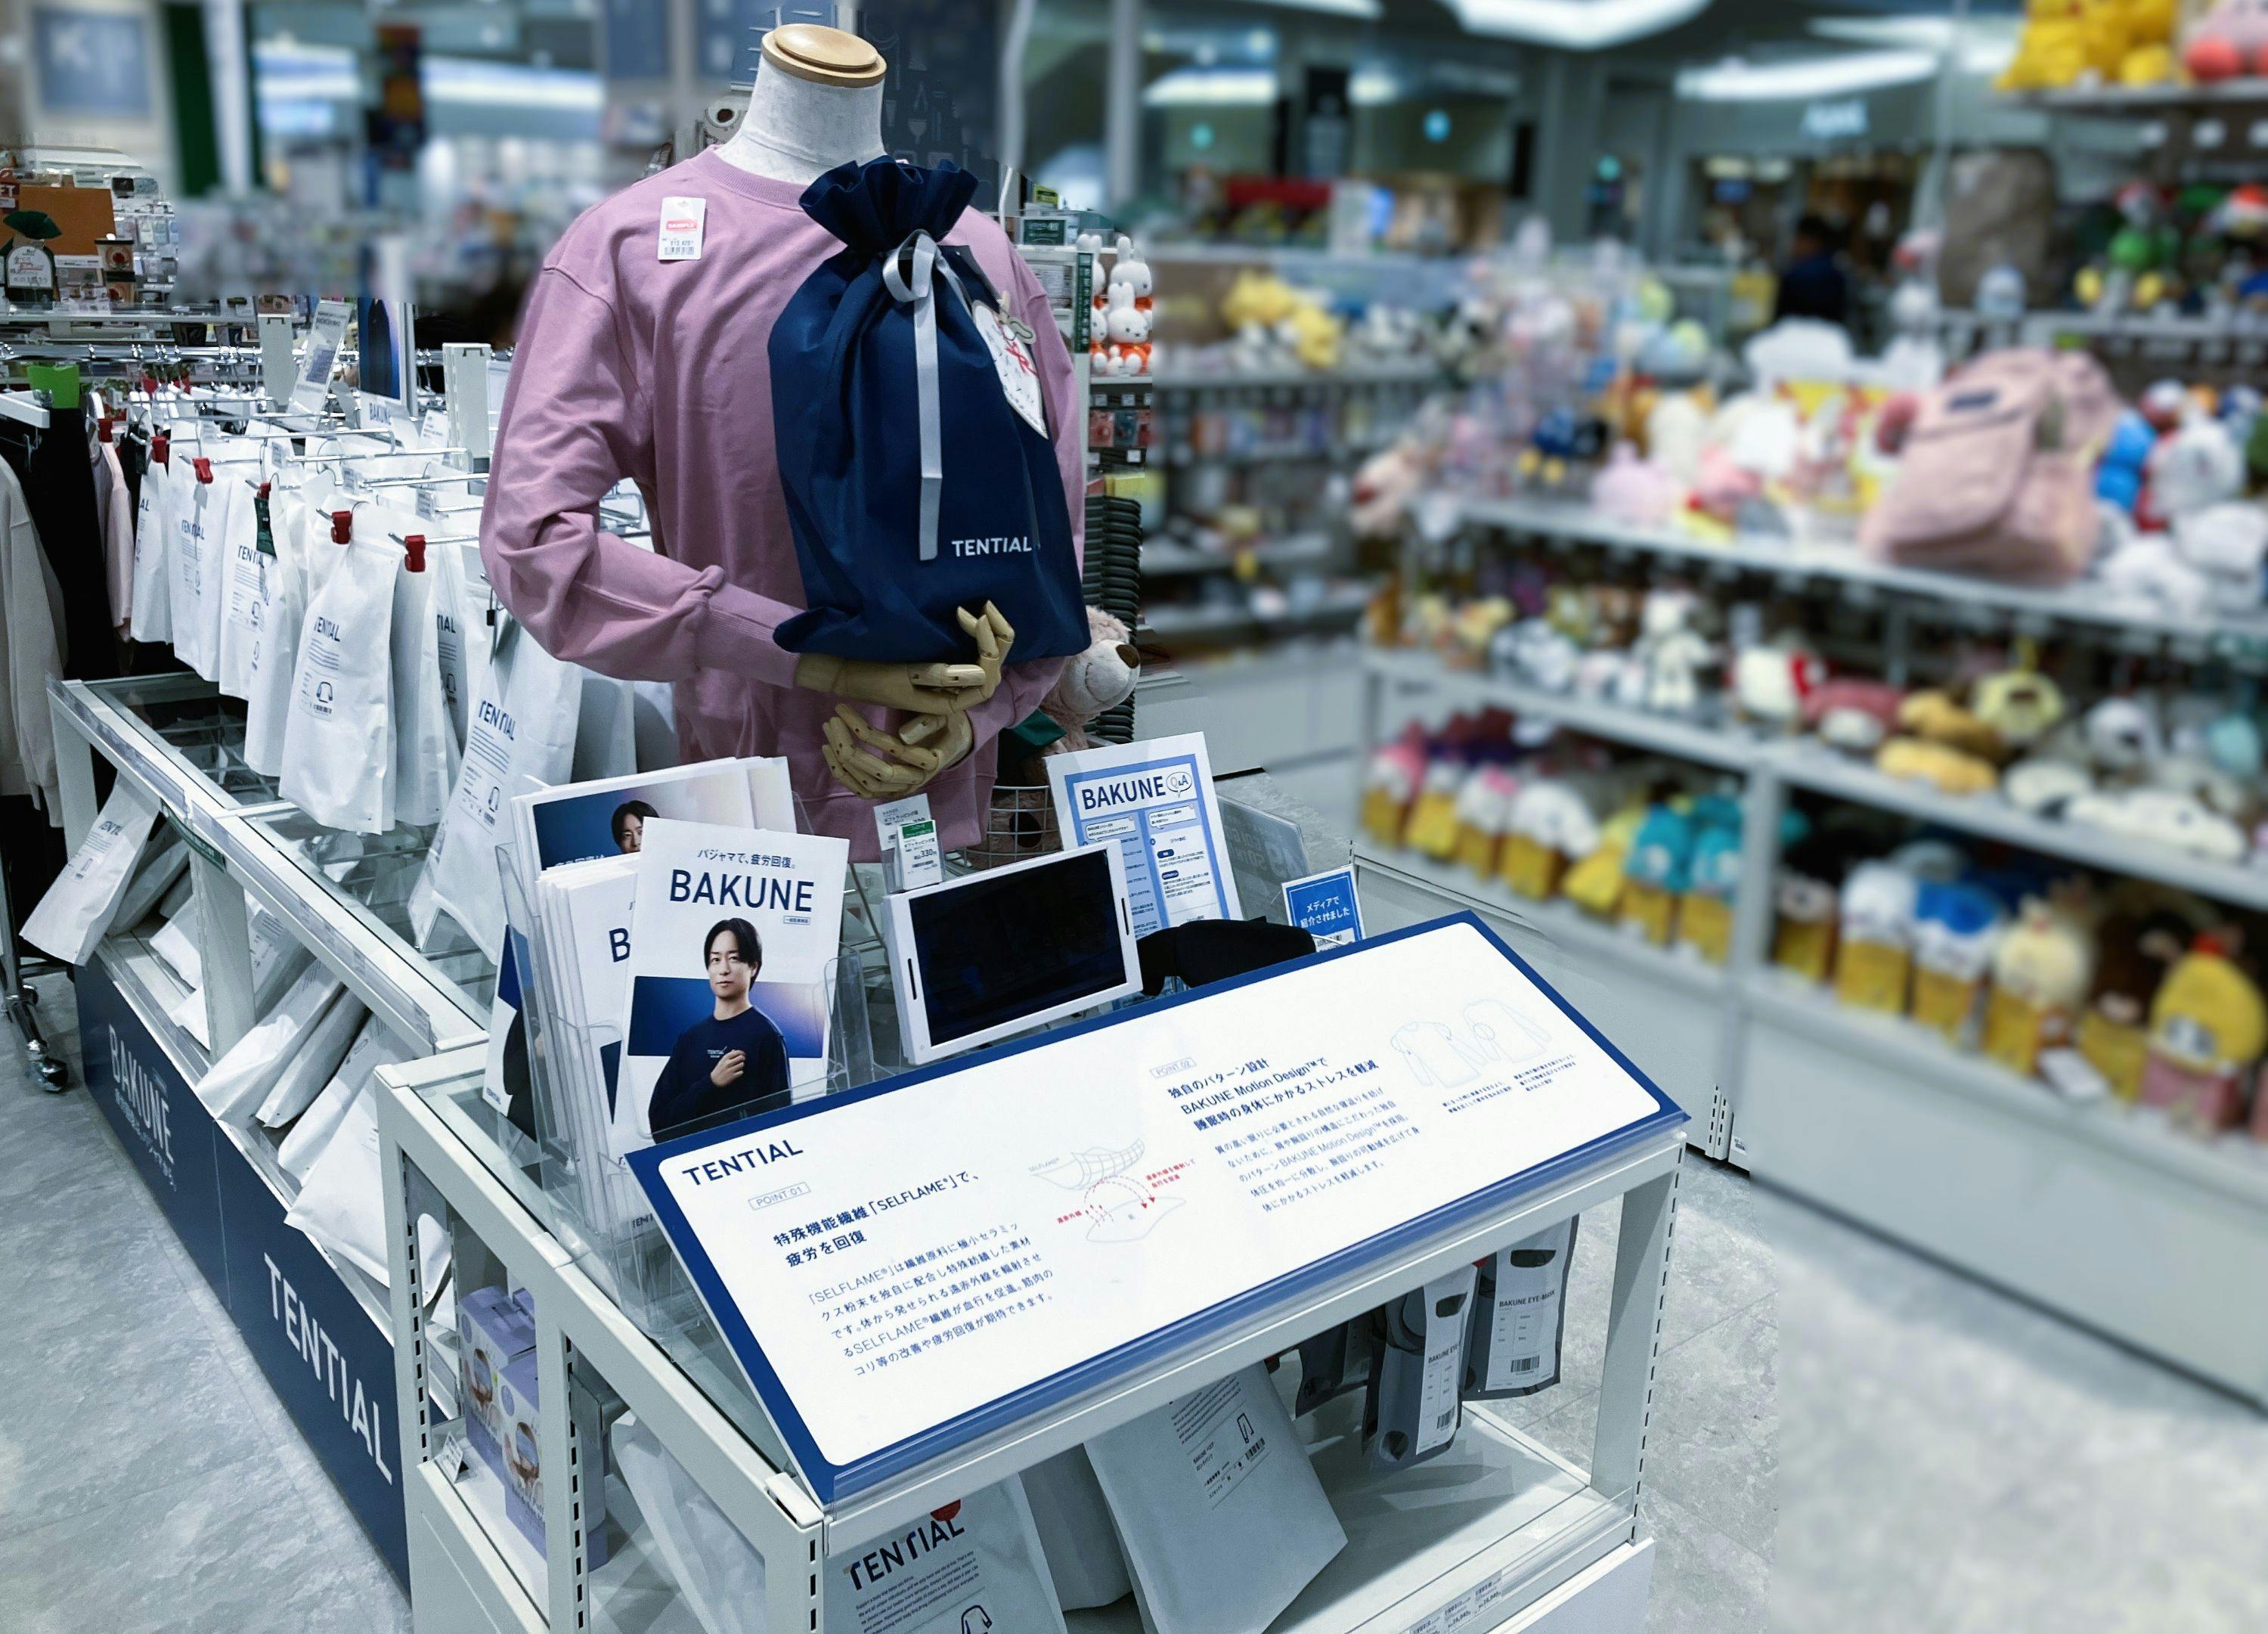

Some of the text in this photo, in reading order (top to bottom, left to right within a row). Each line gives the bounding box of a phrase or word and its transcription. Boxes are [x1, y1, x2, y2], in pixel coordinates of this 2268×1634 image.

[951, 536, 1032, 557] TENTIAL
[314, 616, 340, 642] TENTIAL
[437, 613, 456, 634] TIAL
[479, 699, 516, 741] TENTIAL
[1082, 774, 1189, 810] BAKUNE Q&A
[697, 848, 796, 870] パジャマで、疲労回復。
[669, 869, 815, 913] BAKUNE
[1306, 895, 1340, 916] メディアで
[1300, 906, 1351, 929] 紹介されました
[109, 1023, 175, 1165] BAKUNE
[1167, 1058, 1269, 1099] 独自のパターン設計
[1180, 1089, 1235, 1115] BAKUNE
[1235, 1074, 1274, 1099] Motion
[1194, 1059, 1380, 1132] 睡眠時の身体にかかるストレスを軽減
[682, 1139, 804, 1186] TENTIAL
[785, 1229, 867, 1268] 疲労を回復
[1498, 1296, 1527, 1308] BAKUNE
[854, 1292, 1054, 1377] コリ等の改善や疲労回復が期待できます。
[265, 1252, 392, 1484] TENTIAL
[843, 1520, 965, 1591] TENTIAL
